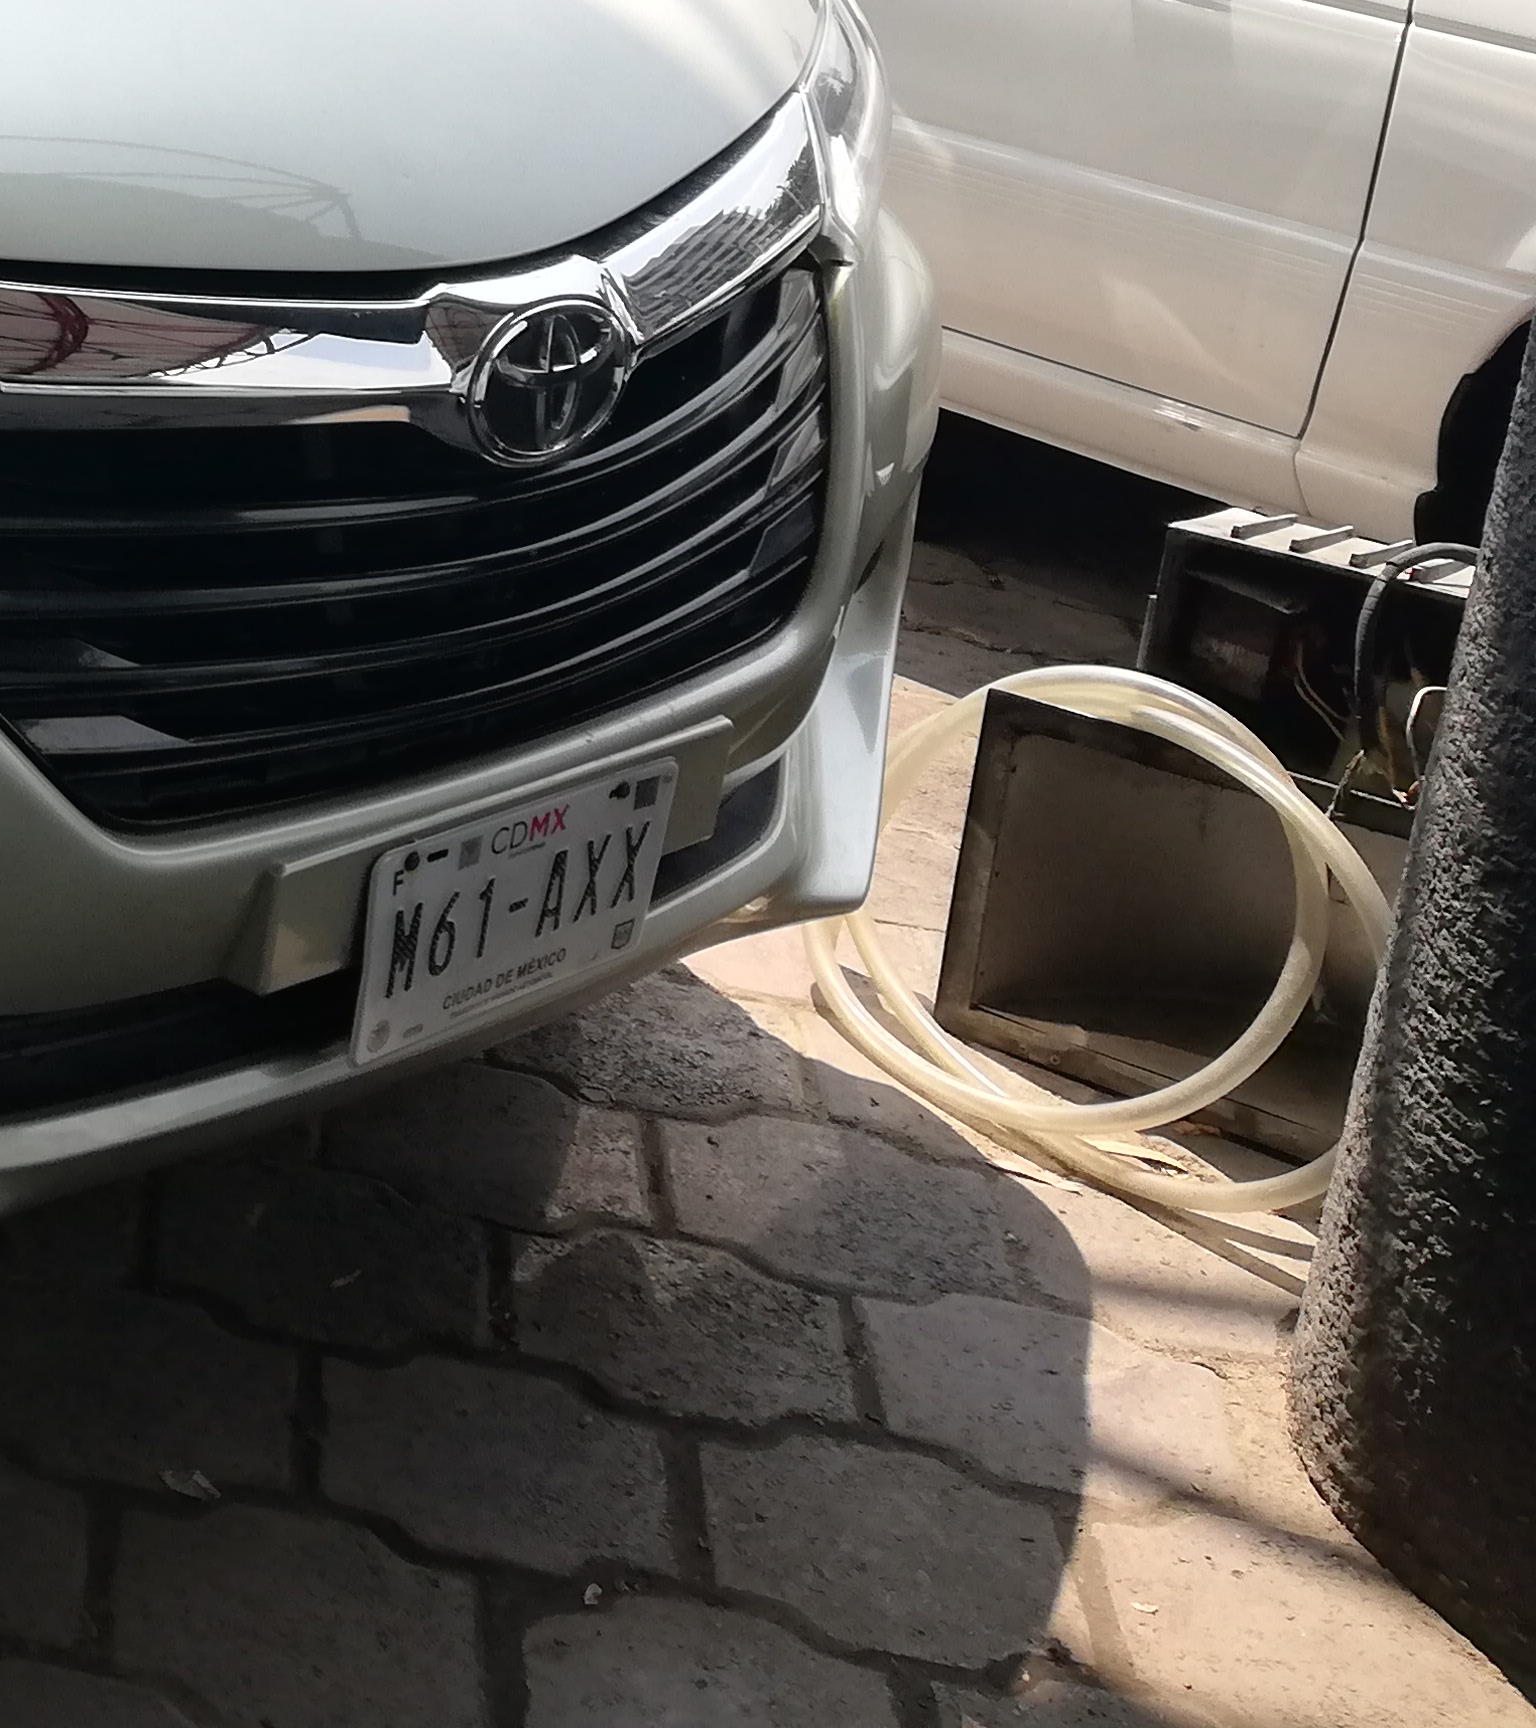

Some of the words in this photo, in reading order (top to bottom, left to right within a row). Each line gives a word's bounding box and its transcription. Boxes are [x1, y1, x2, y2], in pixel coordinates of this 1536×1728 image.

[491, 804, 570, 856] CDMX
[384, 820, 650, 1000] M61-AXX
[442, 978, 493, 1010] CIUDAD
[495, 968, 515, 989] DE
